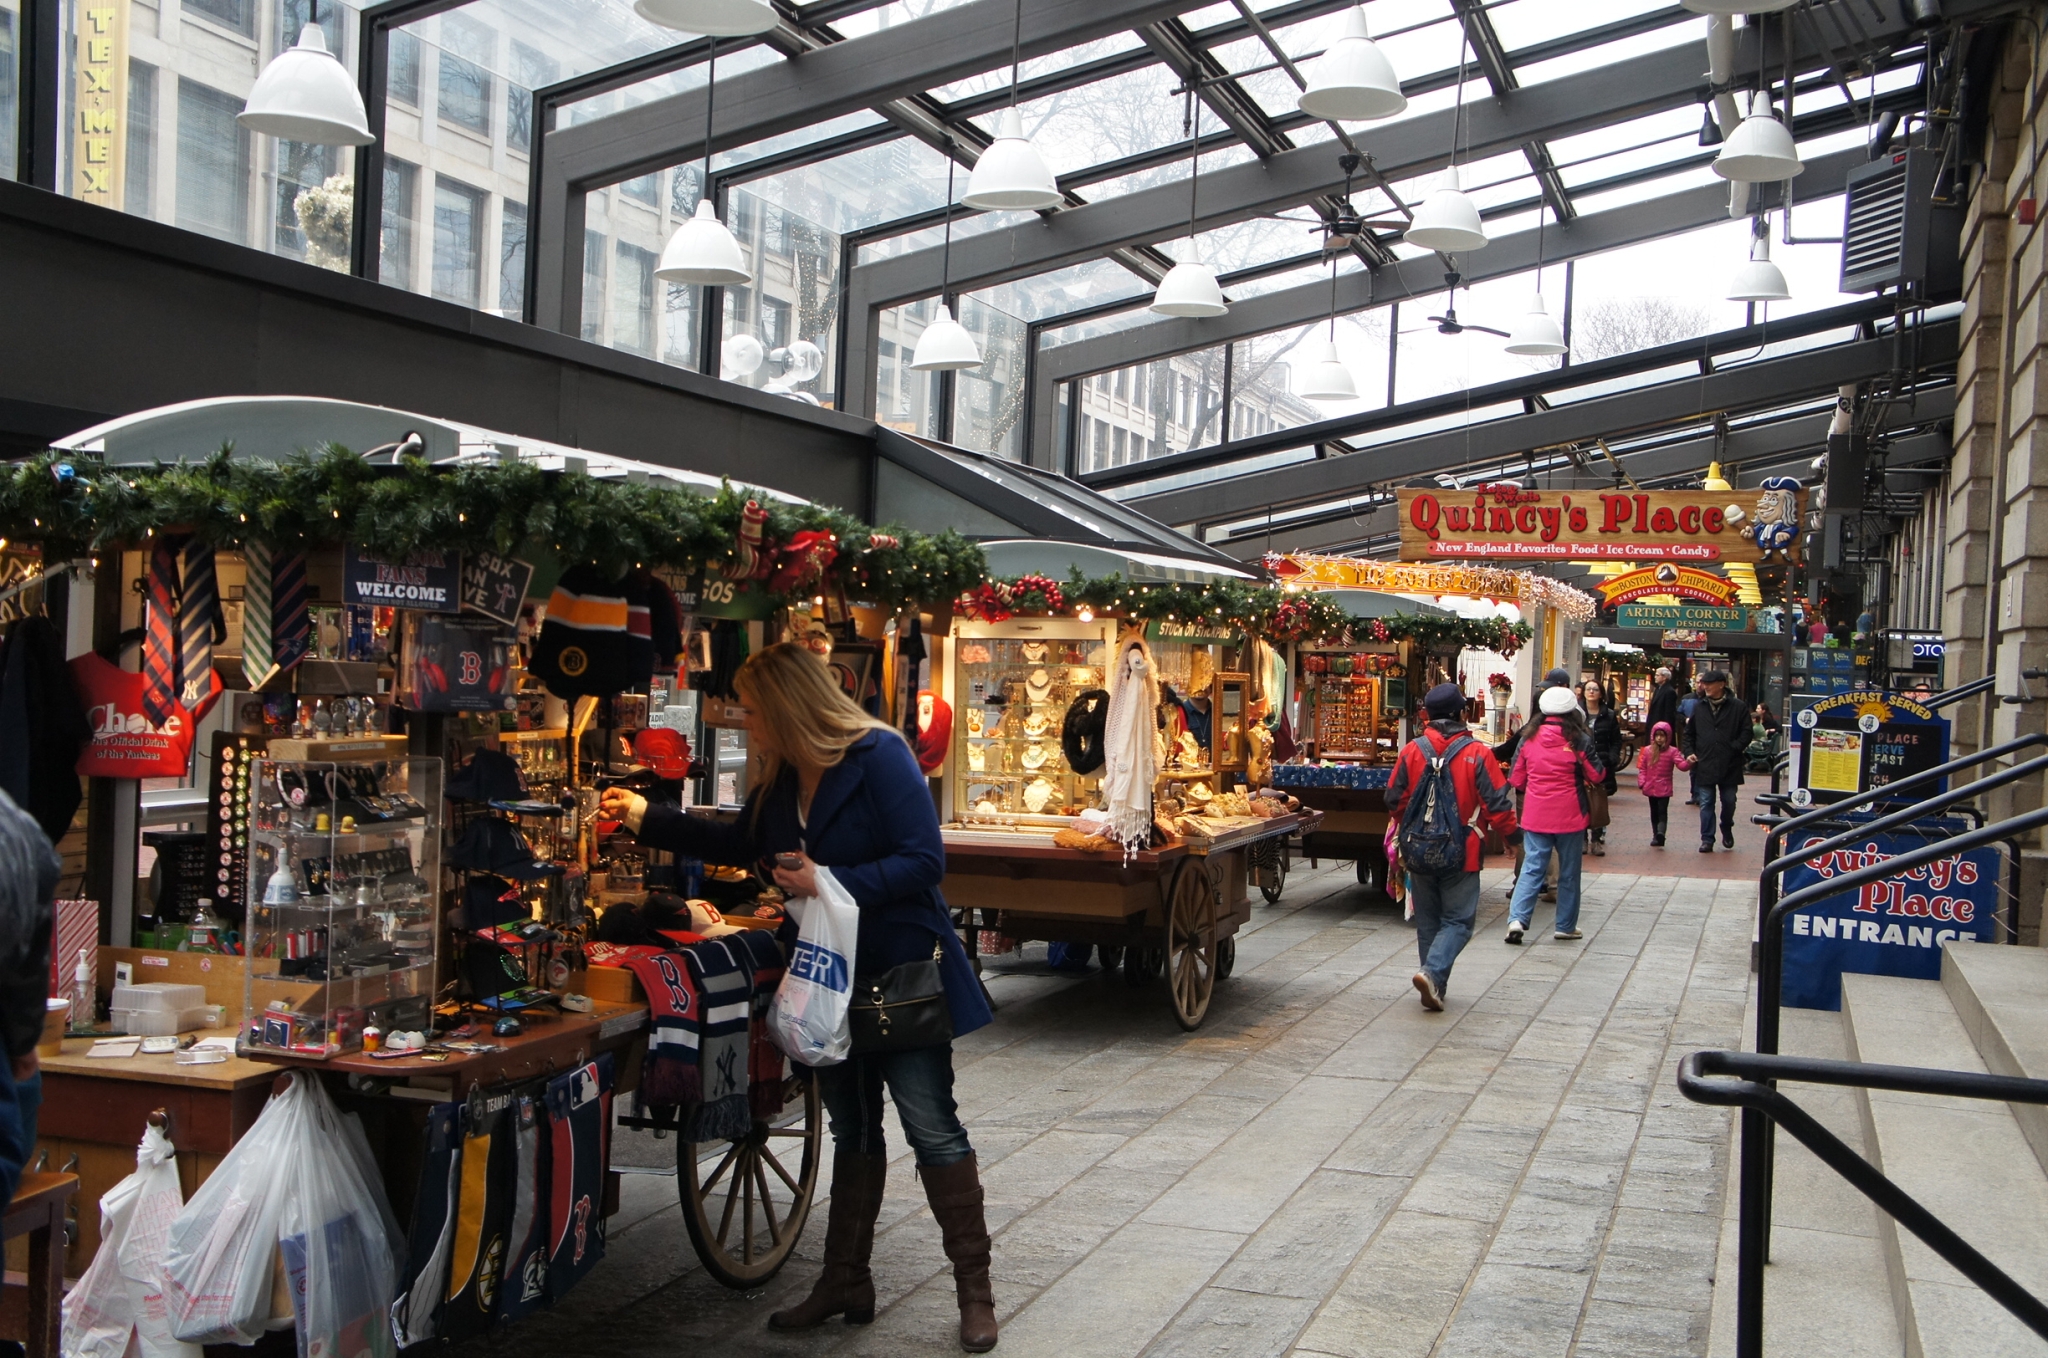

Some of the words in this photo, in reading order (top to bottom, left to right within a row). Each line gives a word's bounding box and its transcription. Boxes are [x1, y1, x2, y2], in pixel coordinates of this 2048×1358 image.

[1494, 491, 1541, 504] Sweets
[1410, 493, 1588, 541] Quincy's
[1599, 494, 1724, 534] Place
[1435, 542, 1463, 552] New
[1465, 543, 1512, 555] England
[1514, 543, 1567, 554] Favorites
[1571, 544, 1599, 554] Food
[1606, 544, 1623, 554] Ice
[1625, 545, 1664, 555] Cream
[1672, 545, 1710, 557] Candy
[479, 551, 514, 579] SOX
[376, 564, 427, 586] FANS
[465, 565, 487, 588] AN
[356, 581, 446, 602] WELCOME
[1610, 584, 1619, 594] THE
[1618, 574, 1652, 592] BOSTON
[1680, 574, 1724, 596] CHIPYARD
[1618, 586, 1659, 602] CHOCOLATE
[1684, 588, 1715, 603] COOKIES
[1625, 607, 1681, 619] ARTISAN
[1685, 608, 1739, 621] CORNER
[1637, 618, 1665, 627] LOCAL
[1676, 619, 1727, 629] DESIGNERS
[1159, 621, 1183, 636] STUCK
[1184, 624, 1195, 637] ON
[1195, 626, 1233, 640] STICKPINS
[1913, 643, 1946, 656] OTO
[459, 652, 482, 684] B
[1813, 692, 1883, 714] BREAKFAST
[1888, 696, 1932, 720] SERVED
[110, 736, 143, 747] Official
[144, 738, 169, 749] Drink
[1877, 733, 1919, 745] PLACE
[96, 749, 107, 759] of
[109, 749, 124, 759] the
[125, 749, 161, 761] Yankees
[1871, 744, 1905, 756] ERVE
[1853, 878, 1975, 923] Place
[649, 954, 691, 1015] B
